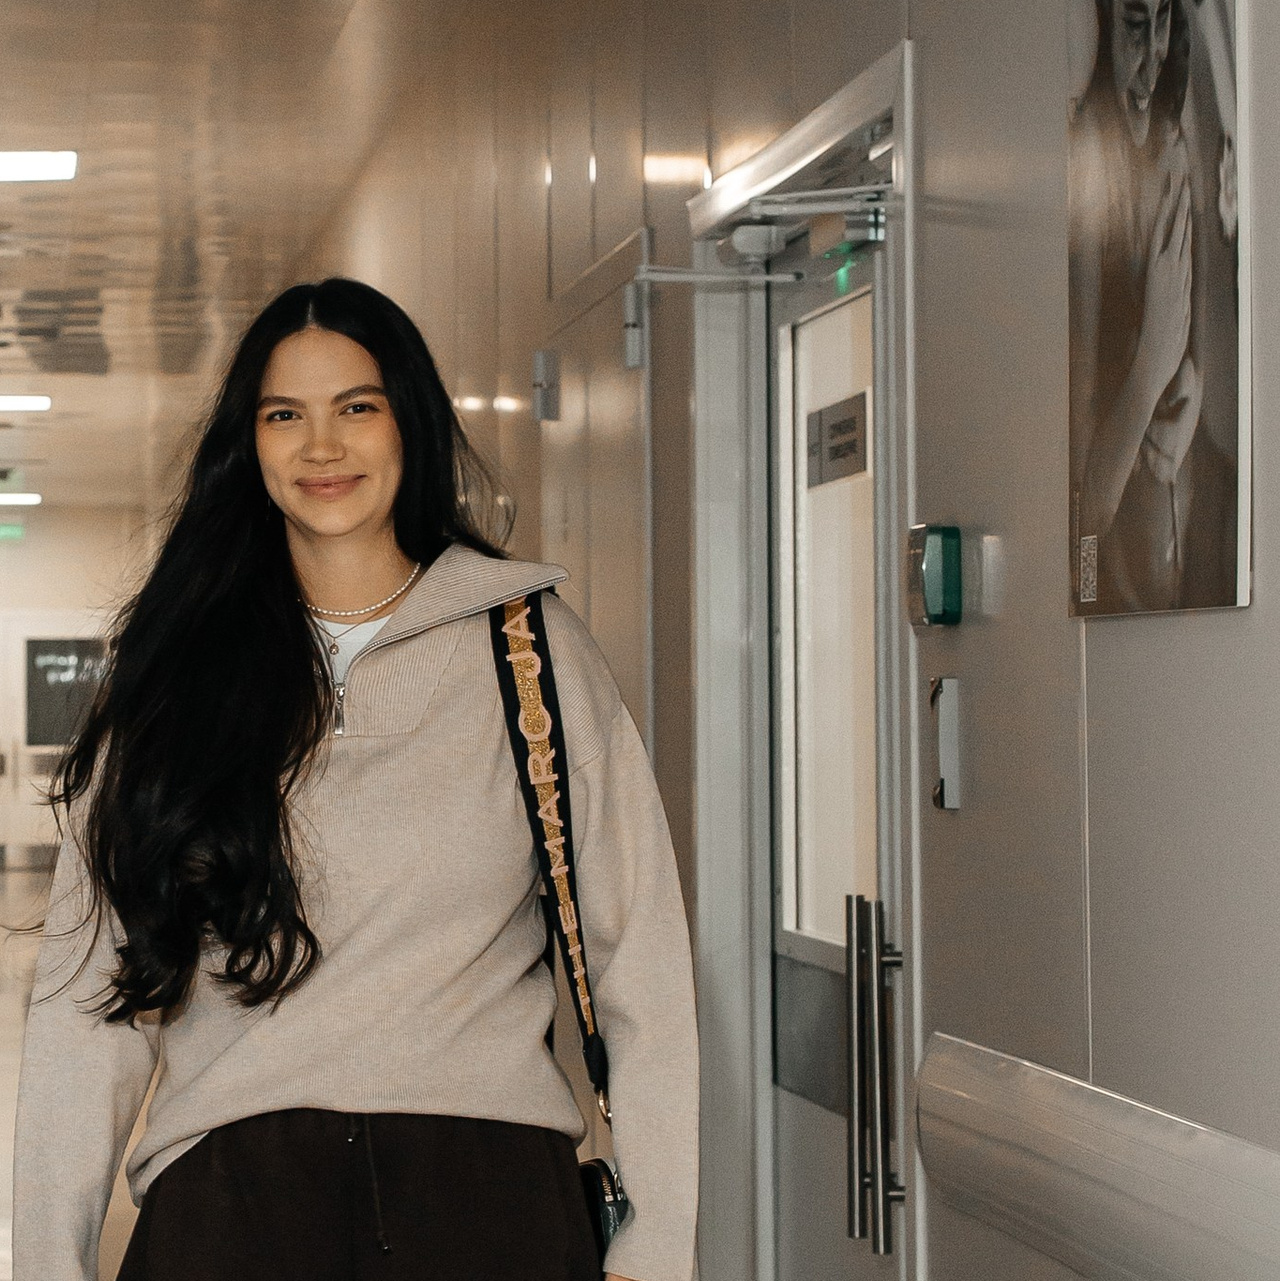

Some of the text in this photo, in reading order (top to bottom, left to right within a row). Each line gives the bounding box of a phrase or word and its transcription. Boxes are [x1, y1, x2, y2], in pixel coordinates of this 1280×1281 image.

[502, 596, 590, 1024] THE MARC JA
